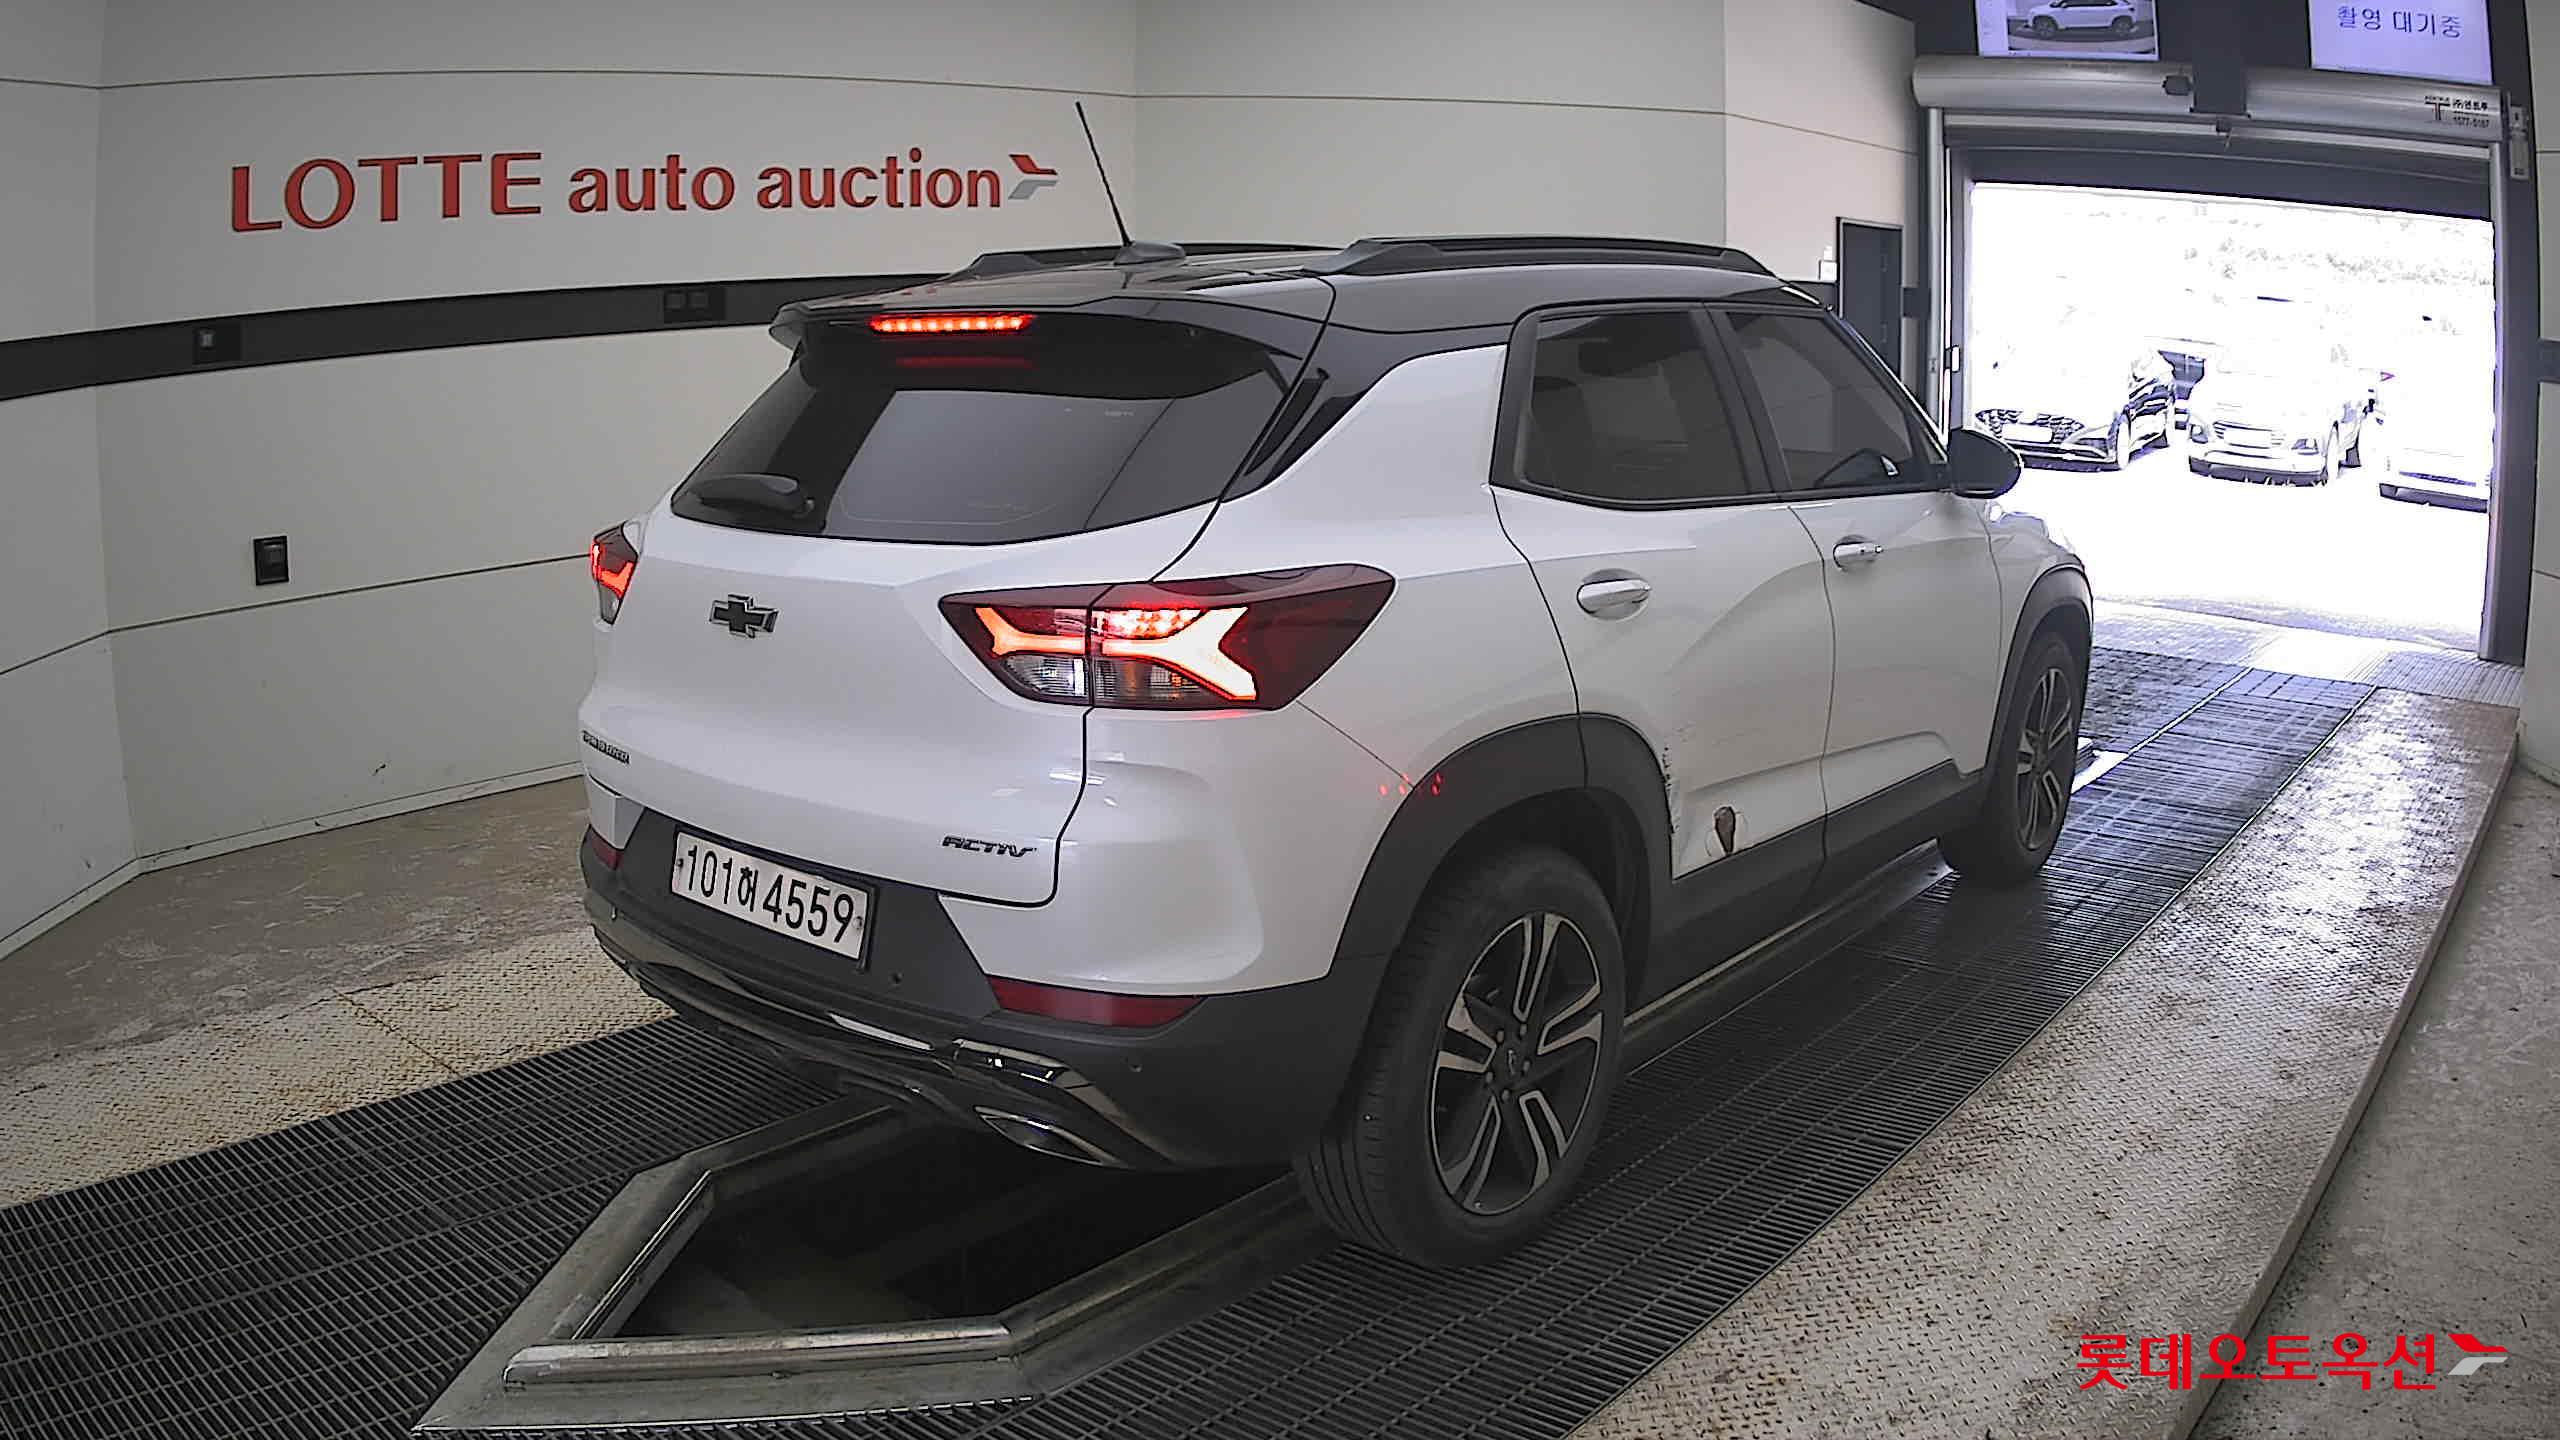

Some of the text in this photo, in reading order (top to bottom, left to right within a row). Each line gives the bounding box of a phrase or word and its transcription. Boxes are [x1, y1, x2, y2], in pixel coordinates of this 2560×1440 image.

[2337, 6, 2463, 38] 촬영 대기중
[231, 147, 1001, 233] LOTTE auto auction
[687, 844, 855, 944] 101허4559
